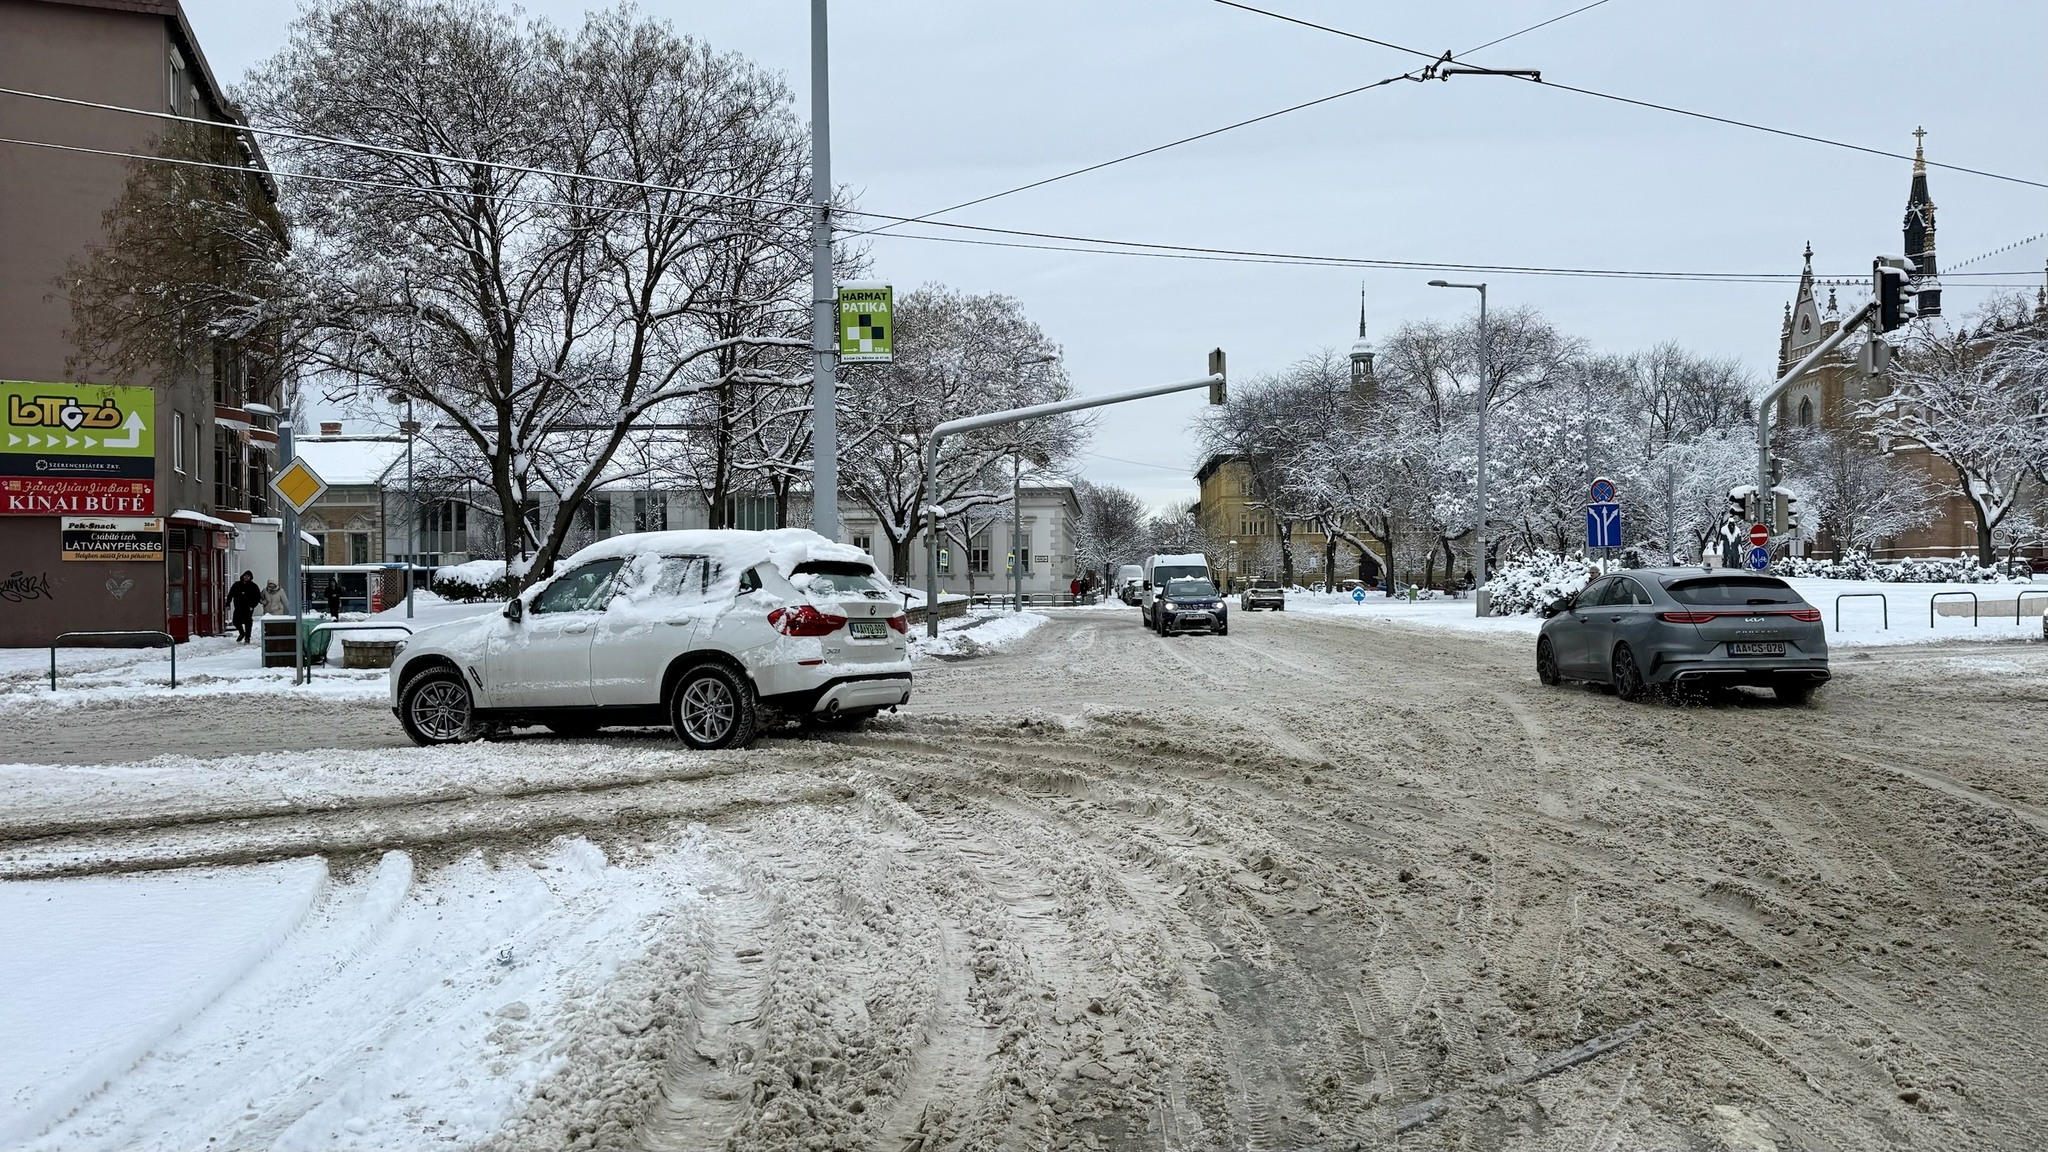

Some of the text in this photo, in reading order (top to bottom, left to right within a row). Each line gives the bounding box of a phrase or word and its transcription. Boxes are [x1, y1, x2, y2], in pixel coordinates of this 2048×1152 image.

[842, 292, 887, 301] HARMAT
[842, 302, 888, 313] PATIKA
[8, 492, 145, 512] KÍNAI BÜFÉ
[68, 522, 117, 530] Pek-Snack
[65, 540, 162, 551] LÁTVÁNYPÉKSÉG
